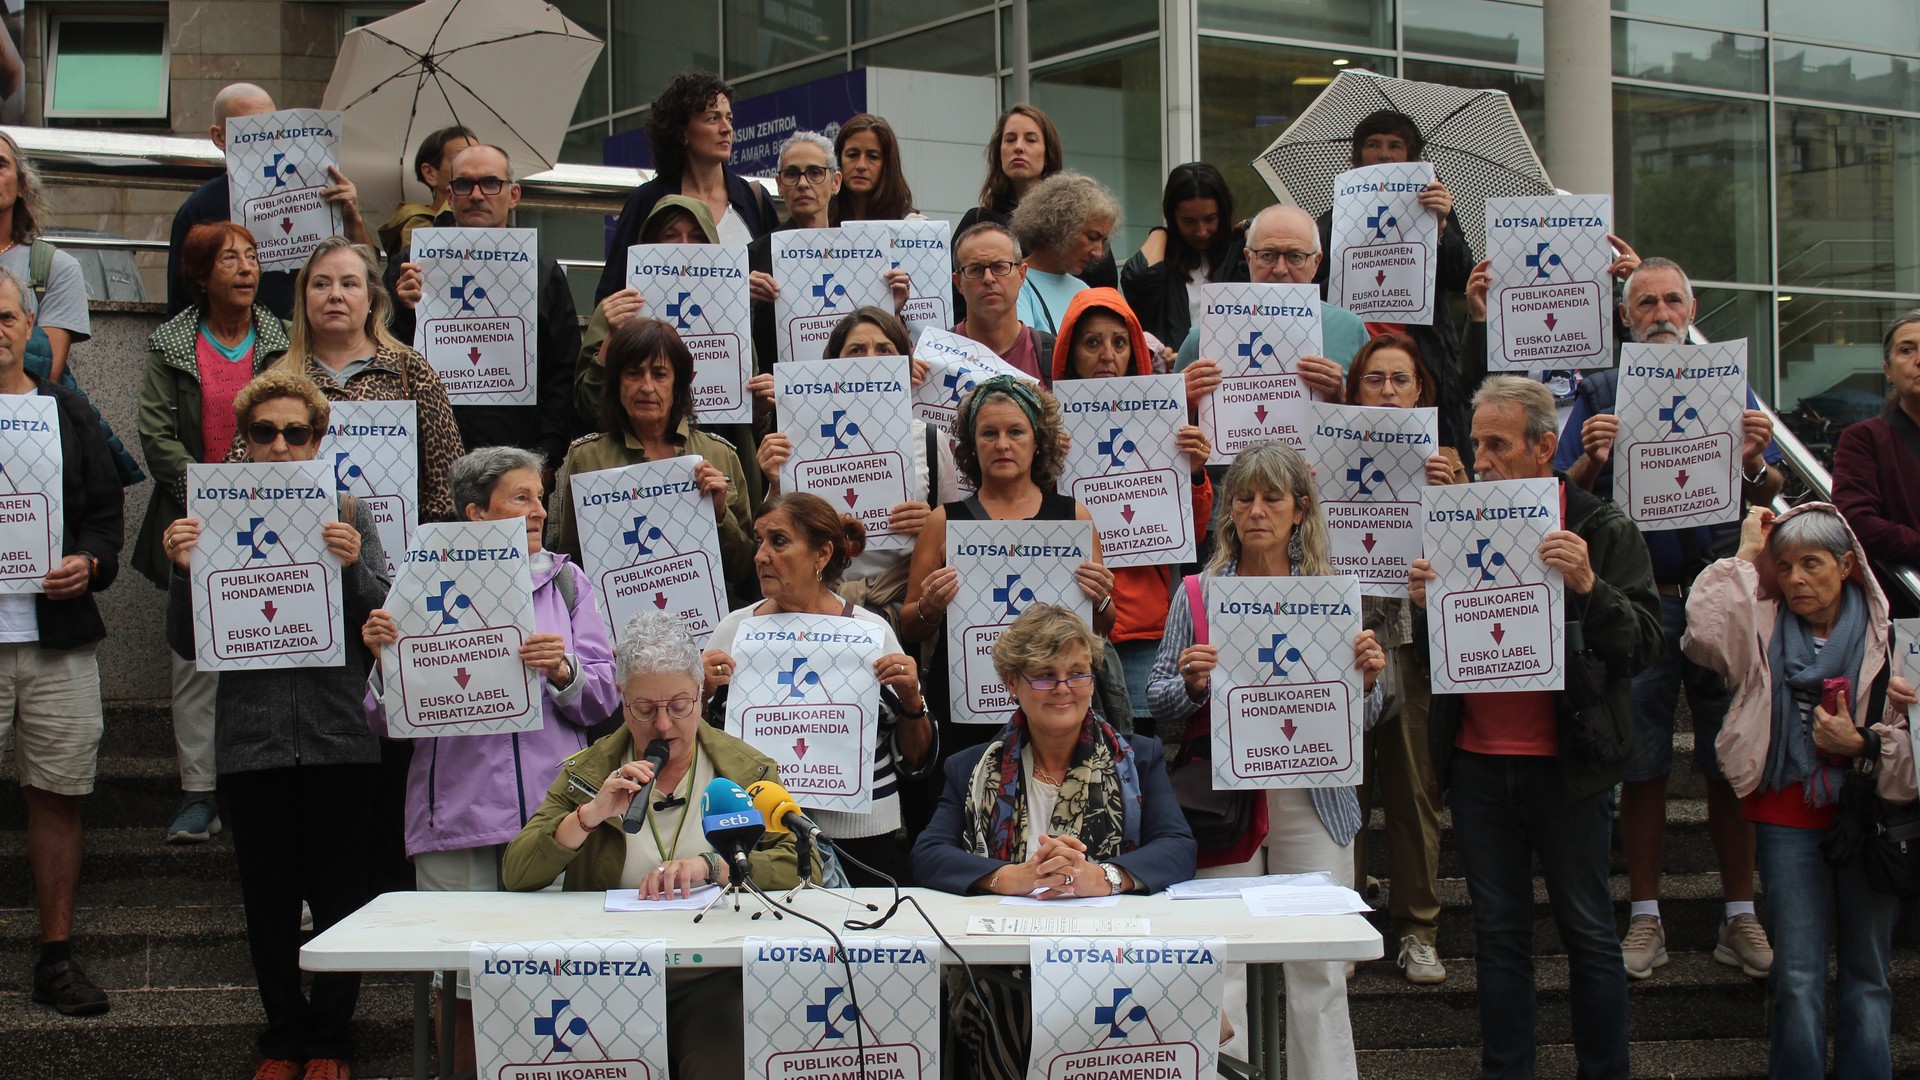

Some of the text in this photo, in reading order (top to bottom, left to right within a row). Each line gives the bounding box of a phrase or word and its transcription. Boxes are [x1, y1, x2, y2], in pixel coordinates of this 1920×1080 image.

[235, 128, 332, 143] LOTSAKIDETZA
[733, 115, 796, 144] ASUN ZENTROA
[741, 144, 770, 161] AMARA
[1340, 182, 1428, 196] LOTSAKIDETZ
[253, 191, 317, 212] PUBLIKOAREN
[254, 202, 322, 222] HONDAMENDIA
[1495, 217, 1602, 228] LOTSAKIDETZA
[291, 233, 321, 245] LABEL
[890, 239, 943, 249] KIDETZA
[419, 249, 528, 262] LOTSAKIDETZA
[781, 249, 882, 259] LOTSAKIDETZA
[1353, 247, 1412, 259] PUBLIKOAREN
[1352, 258, 1416, 270] HONDAMENDIA
[636, 265, 741, 278] LOTSAKIDETZA
[1352, 289, 1411, 300] EUSKO LABEL
[1512, 287, 1585, 301] PUBLIKOAREN
[1208, 304, 1313, 317] LOTSAKIDETZA
[1350, 300, 1413, 311] PRIBATIZAZIOA
[1512, 299, 1590, 312] HONDAMENDIA
[902, 312, 937, 322] MENDIA
[435, 322, 509, 333] PUBLIKOAREN
[800, 319, 840, 331] PUBLIK
[436, 334, 514, 345] HONDAMENDIA
[1516, 332, 1587, 345] EUSKO LABEL
[1514, 343, 1591, 357] PRIBATIZAZIOA
[439, 368, 511, 379] EUSKO LABEL
[1628, 365, 1739, 379] LOTSAKIDETZA
[444, 379, 514, 390] RIBATIZAZIOA
[694, 386, 726, 395] LABEL
[785, 382, 901, 394] LOTSAKIDETZA
[1223, 379, 1296, 391] PUBLIKOAREN
[1223, 391, 1301, 403] HONDAMENDIA
[1064, 399, 1178, 413] LOTSAKIDETZA
[328, 424, 407, 436] AKIDETZA
[1228, 426, 1298, 438] EUSKO LABEL
[1317, 425, 1431, 444] LOTSAKIDETZA
[1641, 440, 1717, 457] PUBLIKOAREN
[807, 458, 887, 476] PUBLIKOAREN
[1641, 451, 1721, 469] HONDAMENDIA
[808, 470, 892, 489] HONDAMENDIA
[1084, 475, 1162, 492] PUBLIKOAREN
[197, 487, 326, 500] LOTSAKIDETZA
[583, 481, 700, 507] LOTSAKIDETZA
[1085, 487, 1168, 505] HONDAMENDIA
[1644, 487, 1716, 505] EUSKO LABEL
[856, 508, 891, 520] LABEL
[1329, 507, 1408, 516] PUBLIKOAREN
[1429, 507, 1549, 522] LOTSAKIDETZA
[1641, 498, 1719, 517] PRIBATIZAZIOA
[1328, 520, 1412, 529] HONDAMENDIA
[1099, 524, 1167, 540] USKO LABEL
[958, 544, 1082, 557] LOTSAKIDETZA
[1101, 536, 1173, 552] RIBATIZAZIOA
[0, 551, 32, 561] ABEL
[403, 548, 519, 562] OTSAKIDETZA
[1330, 556, 1407, 566] EUSKO LABEL
[221, 570, 309, 586] PUBLIKOAREN
[614, 559, 693, 584] PUBLIKOAREN
[1336, 570, 1409, 578] RIBATIZAZIOA
[616, 571, 700, 597] HONDAMENDIA
[222, 583, 315, 600] HONDAMENDIA
[1455, 591, 1534, 609] PUBLIKOAREN
[681, 608, 703, 620] BEL
[1221, 602, 1351, 616] LOTSAKIDETZA
[1456, 604, 1539, 622] HONDAMENDIA
[228, 623, 313, 640] EUSKO LABEL
[746, 631, 873, 644] LOTSAKIDETZA
[226, 636, 318, 654] PRIBATIZAZIOA
[412, 634, 504, 653] PUBLIKOAREN
[413, 647, 510, 667] HONDAMENDIA
[1461, 646, 1536, 662] EUSKO LABEL
[1459, 660, 1540, 676] PRIBATIZAZIOA
[982, 684, 1007, 694] EUS
[1242, 688, 1330, 703] PUBLIKOAREN
[420, 688, 509, 708] EUSKO LABEL
[419, 702, 515, 721] PRIBATIZAZIOA
[756, 710, 845, 722] PUBLIKOAREN
[1242, 702, 1336, 717] HONDAMENDIA
[755, 724, 849, 736] HONDAMENDIA
[1247, 743, 1333, 758] EUSKO LABEL
[804, 764, 842, 775] LABEL
[1245, 757, 1338, 772] PRIBATIZAZIOA
[783, 777, 846, 789] ATIZAZIOA
[720, 814, 749, 826] etb
[759, 946, 926, 963] LOTSAKIDETZA
[1047, 948, 1213, 964] LOTSAKIDETZA
[485, 959, 652, 976] LOTSAKIDETZA
[784, 1052, 897, 1072] PUBLIKOAREN
[1066, 1050, 1175, 1070] PUBLIKOAREN
[516, 1068, 627, 1080] PUBLIKOAREN
